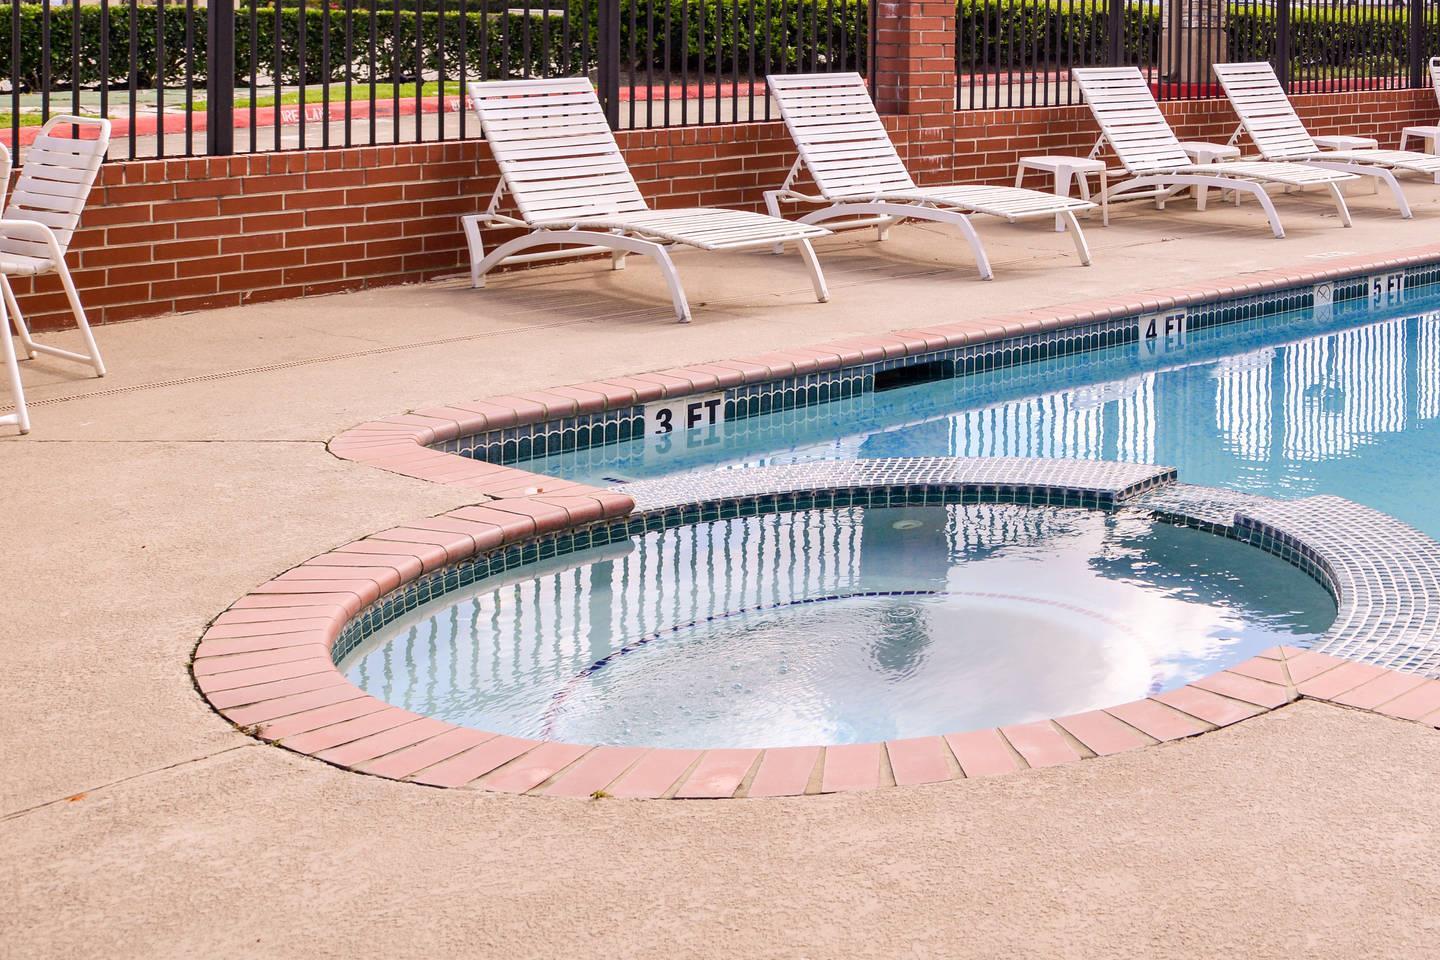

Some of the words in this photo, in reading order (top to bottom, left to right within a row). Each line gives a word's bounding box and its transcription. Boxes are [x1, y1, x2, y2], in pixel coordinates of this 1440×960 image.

[1373, 277, 1382, 295] 5
[1387, 273, 1403, 293] FT
[1145, 318, 1157, 339] 4
[1165, 313, 1185, 337] FT
[655, 408, 673, 434] 3
[687, 398, 721, 428] FT
